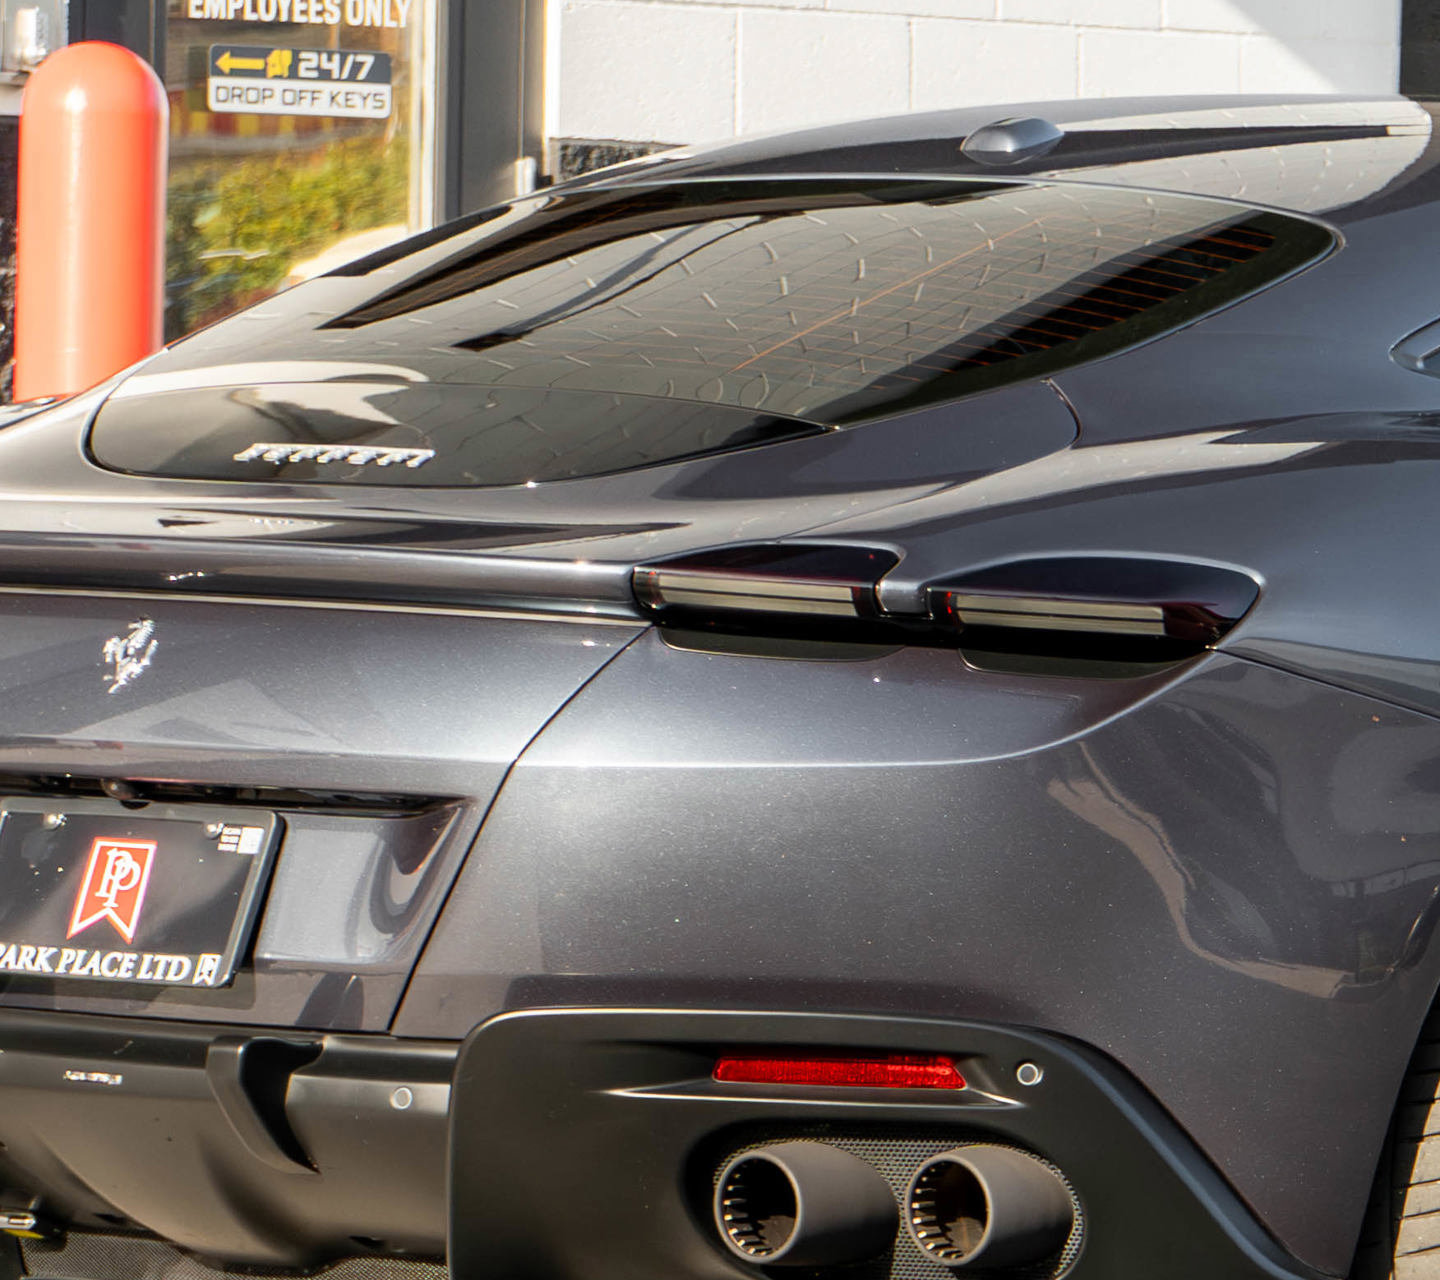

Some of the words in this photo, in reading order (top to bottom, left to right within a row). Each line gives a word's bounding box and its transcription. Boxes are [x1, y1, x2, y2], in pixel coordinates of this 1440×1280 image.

[297, 51, 376, 81] 24/7
[215, 85, 275, 105] DROP
[281, 88, 324, 107] OFF
[328, 90, 387, 111] KEYS
[55, 946, 138, 978] PLACE
[136, 953, 192, 982] LTD
